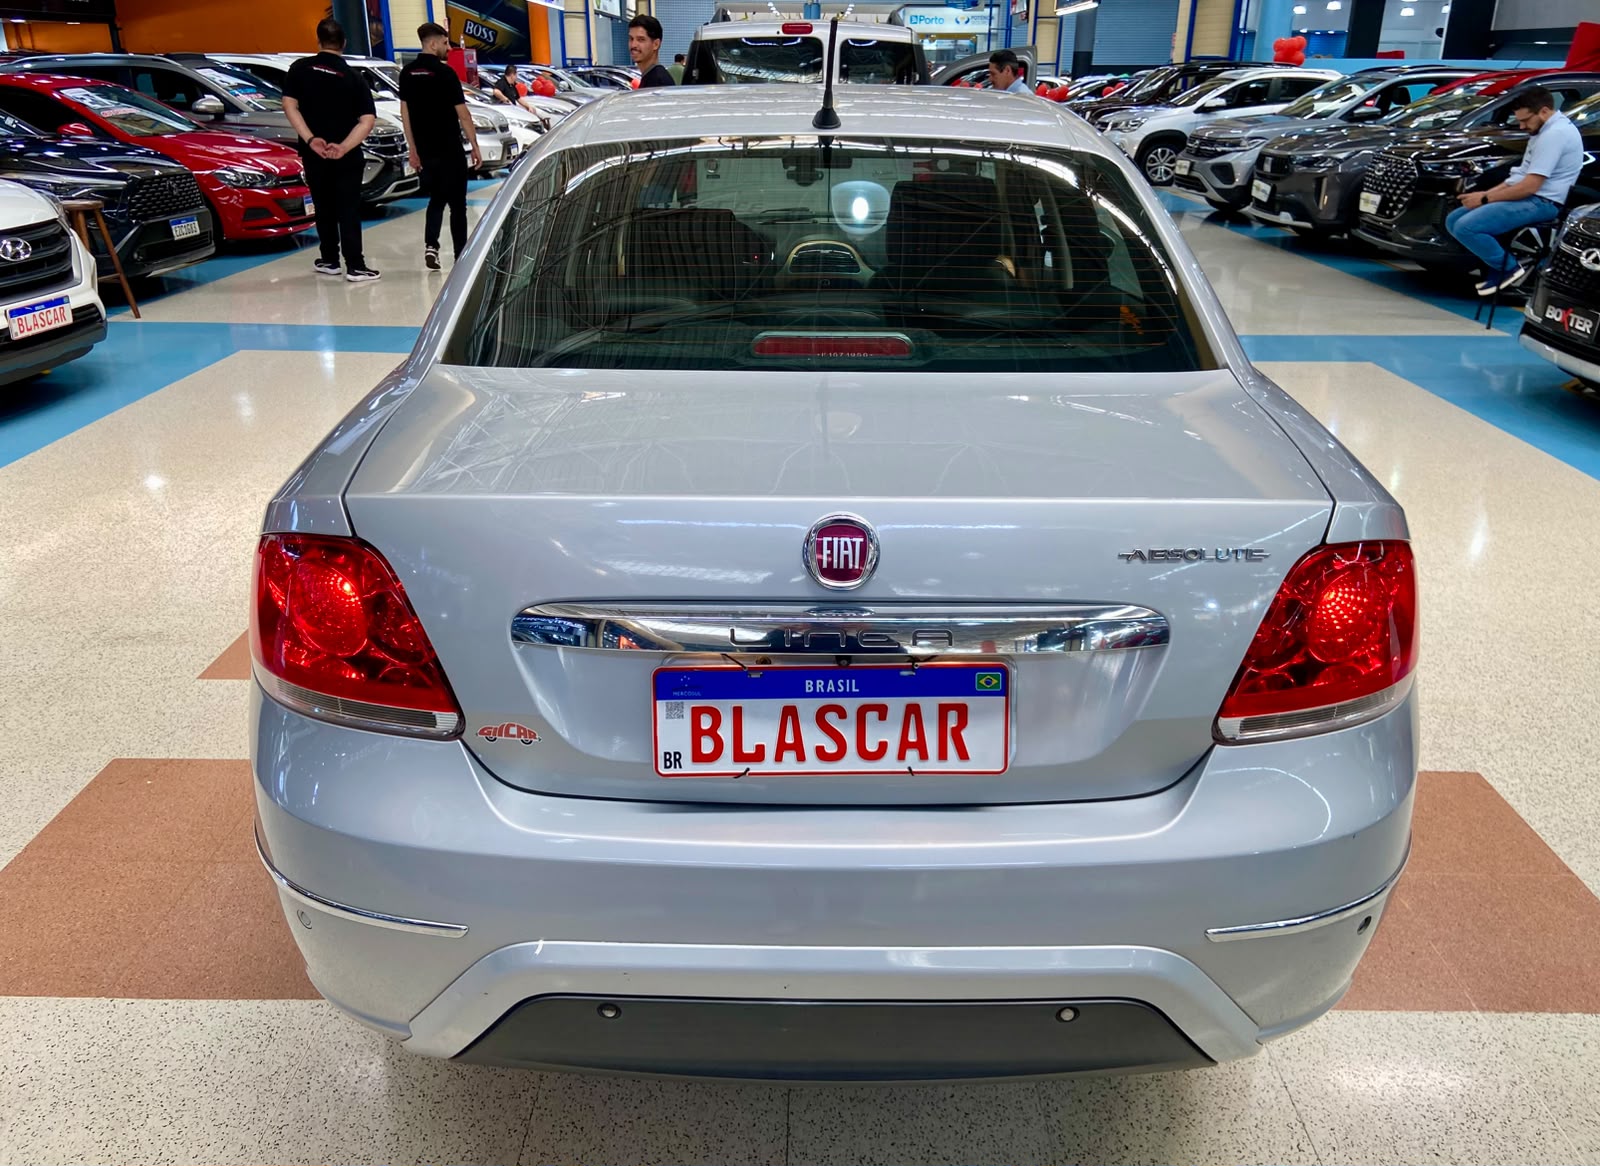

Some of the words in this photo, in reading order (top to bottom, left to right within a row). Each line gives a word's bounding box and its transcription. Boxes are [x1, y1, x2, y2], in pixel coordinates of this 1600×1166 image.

[917, 14, 945, 25] Porto
[464, 20, 496, 43] BOSS
[16, 306, 67, 334] BLASCAR
[1545, 304, 1593, 334] BOXTER
[822, 536, 864, 570] FIAT
[1118, 548, 1271, 564] ABSOLUTE
[728, 627, 954, 648] LINEA
[804, 679, 860, 693] BRASIL
[690, 703, 971, 763] BLASCAR
[663, 751, 683, 769] BR
